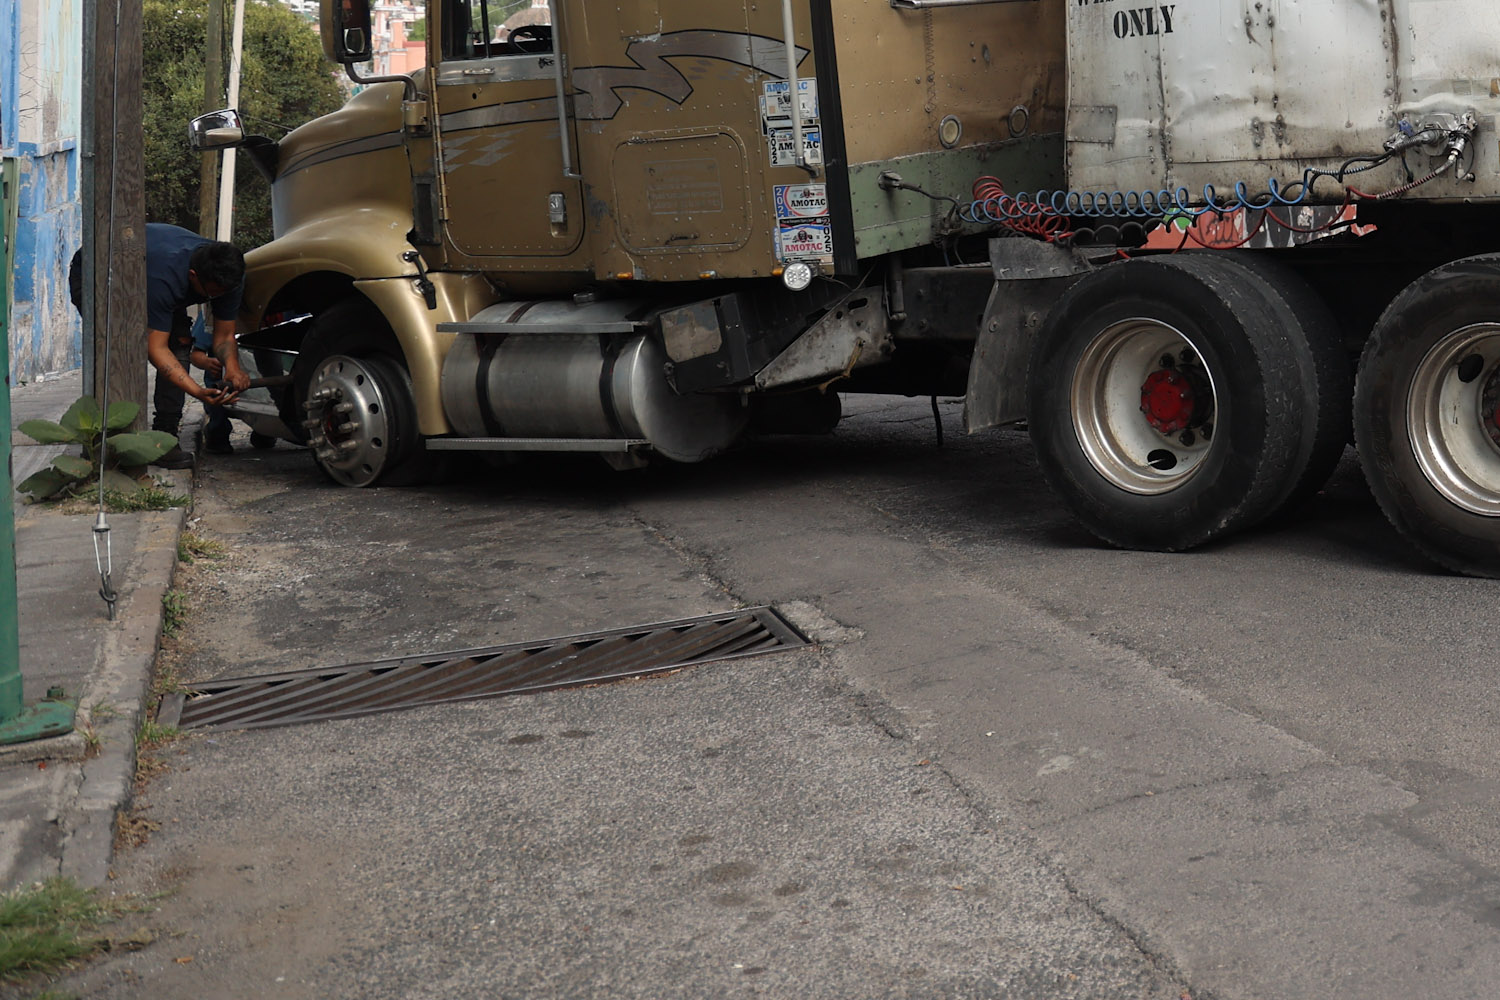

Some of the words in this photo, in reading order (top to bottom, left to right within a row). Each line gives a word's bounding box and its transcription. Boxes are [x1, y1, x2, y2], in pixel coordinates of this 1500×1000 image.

[1113, 5, 1176, 39] ONLY
[766, 82, 808, 92] AMOAC
[770, 129, 778, 165] 2022
[791, 198, 826, 207] AMOTAC
[822, 218, 832, 253] 2025
[785, 243, 823, 252] AMOTAC
